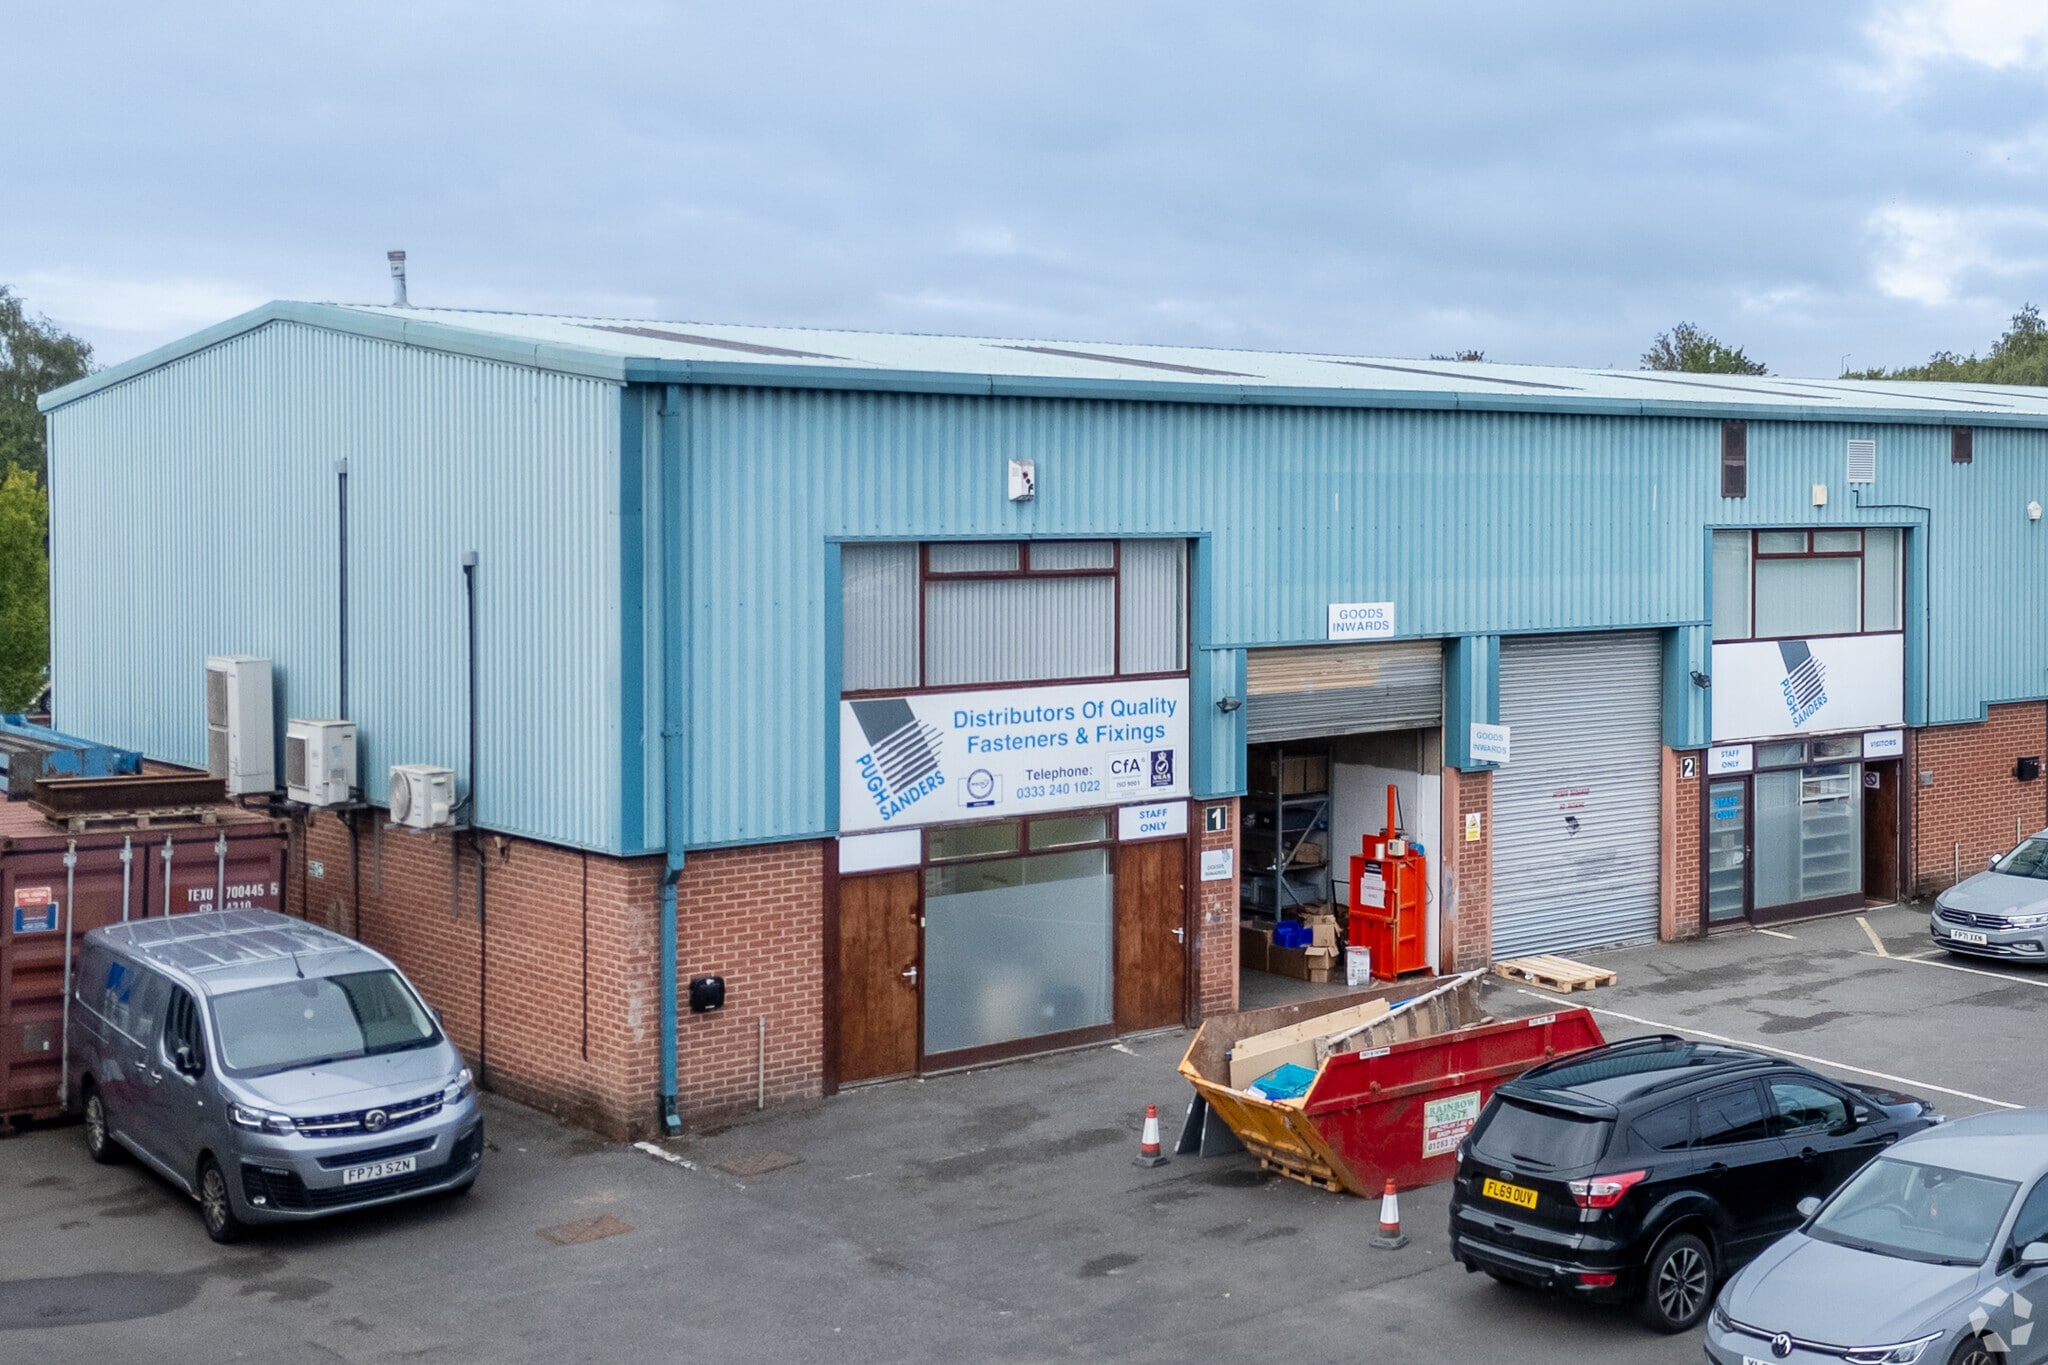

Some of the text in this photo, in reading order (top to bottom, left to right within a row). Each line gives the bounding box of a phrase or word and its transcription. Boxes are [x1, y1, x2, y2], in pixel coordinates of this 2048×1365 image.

[1339, 608, 1383, 619] GOODS
[1332, 620, 1390, 632] INWARDS
[1780, 678, 1799, 716] PUGH
[954, 697, 1177, 729] Distributors Of Quality
[1792, 692, 1828, 728] SANDERS
[967, 724, 1165, 753] Fasteners & Fixings
[1476, 731, 1504, 742] GOODS
[1870, 739, 1897, 748] VISITORS
[1472, 744, 1507, 755] INWARDS
[1721, 750, 1739, 758] STAFF
[1111, 758, 1141, 774] CfA
[1684, 758, 1694, 777] 2
[1721, 761, 1739, 769] ONLY
[856, 753, 890, 806] PUGH
[1026, 766, 1093, 781] Telephone:
[880, 770, 945, 821] SANDERS
[1016, 780, 1100, 799] 0333 240 1022
[1714, 796, 1738, 807] STAFF
[1139, 808, 1167, 819] STAFF
[1211, 808, 1222, 830] 1
[1715, 809, 1737, 820] ONLY
[1140, 821, 1167, 832] ONLY
[187, 888, 214, 902] TEXU
[226, 884, 264, 899] 700445
[1428, 1098, 1475, 1117] RAINBOW
[1436, 1109, 1468, 1123] WASTE
[348, 1159, 411, 1181] FP73 SZN
[1487, 1181, 1533, 1204] FL69 OUY
